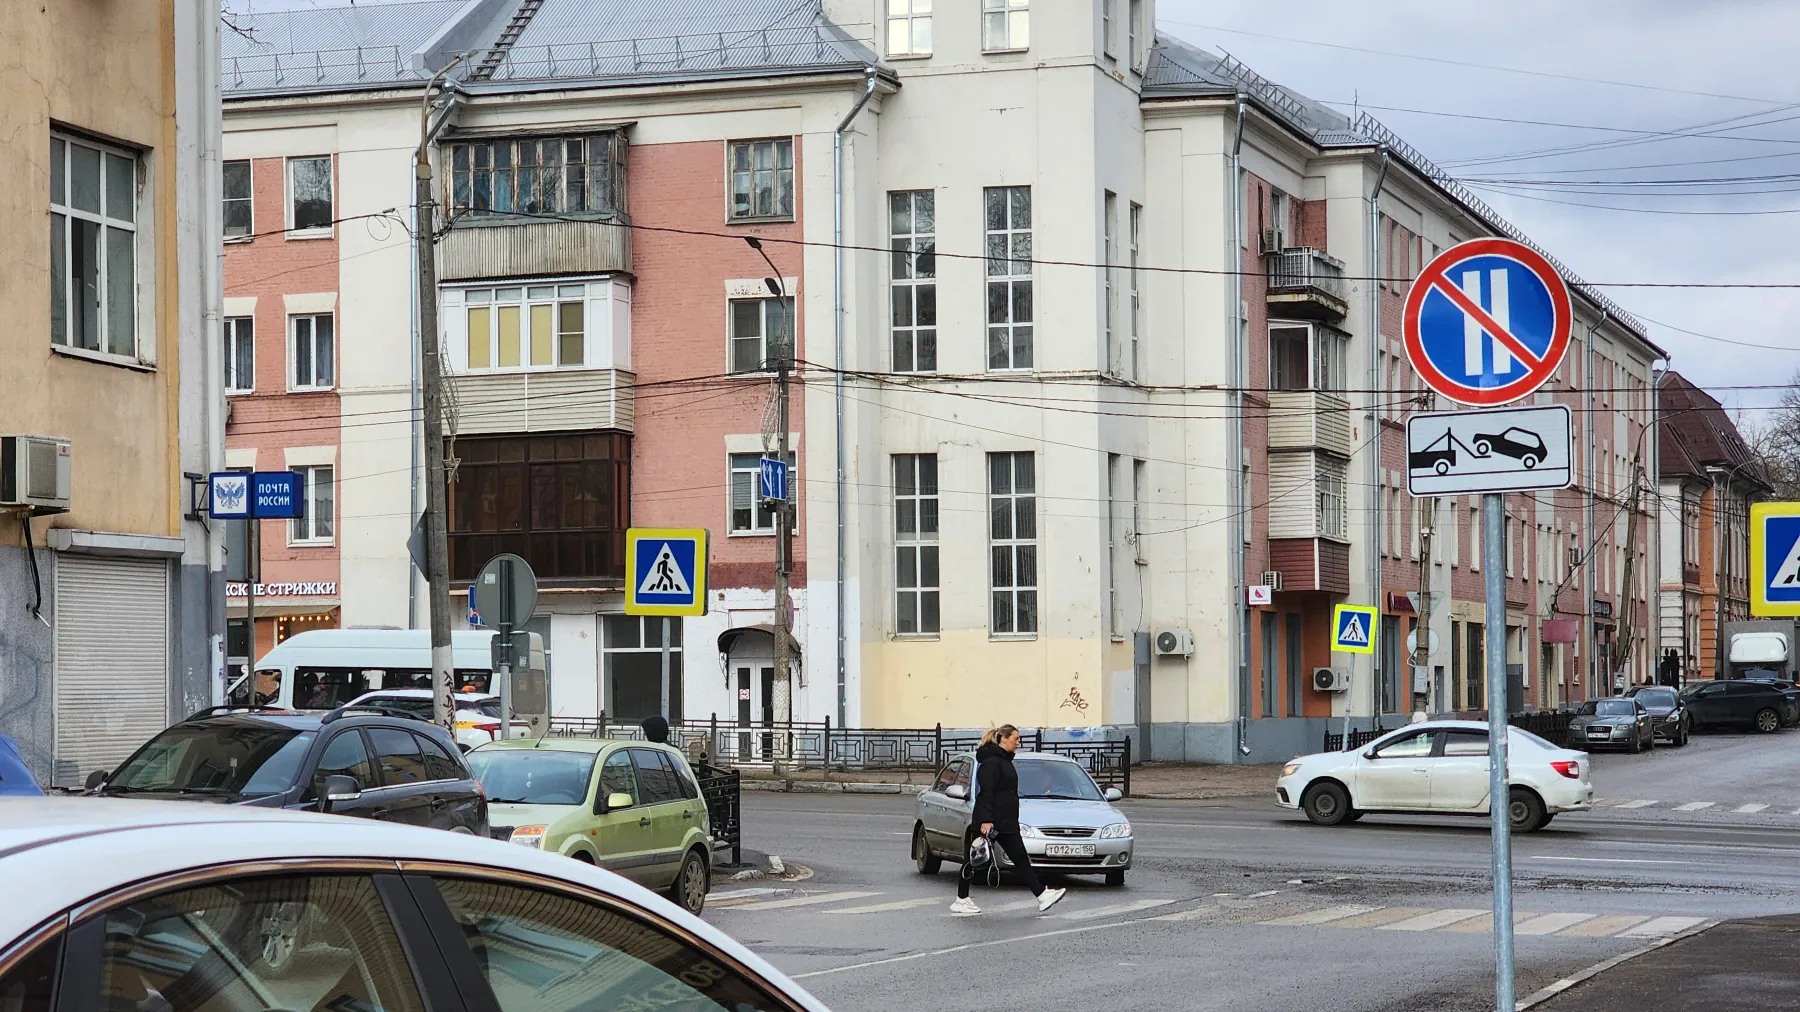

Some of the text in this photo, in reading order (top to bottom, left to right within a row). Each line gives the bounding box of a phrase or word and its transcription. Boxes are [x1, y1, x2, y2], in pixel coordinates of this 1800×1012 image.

[258, 483, 290, 493] ПОЧТА
[258, 495, 290, 506] РОССИИ
[267, 582, 337, 596] СТРИЖКИ
